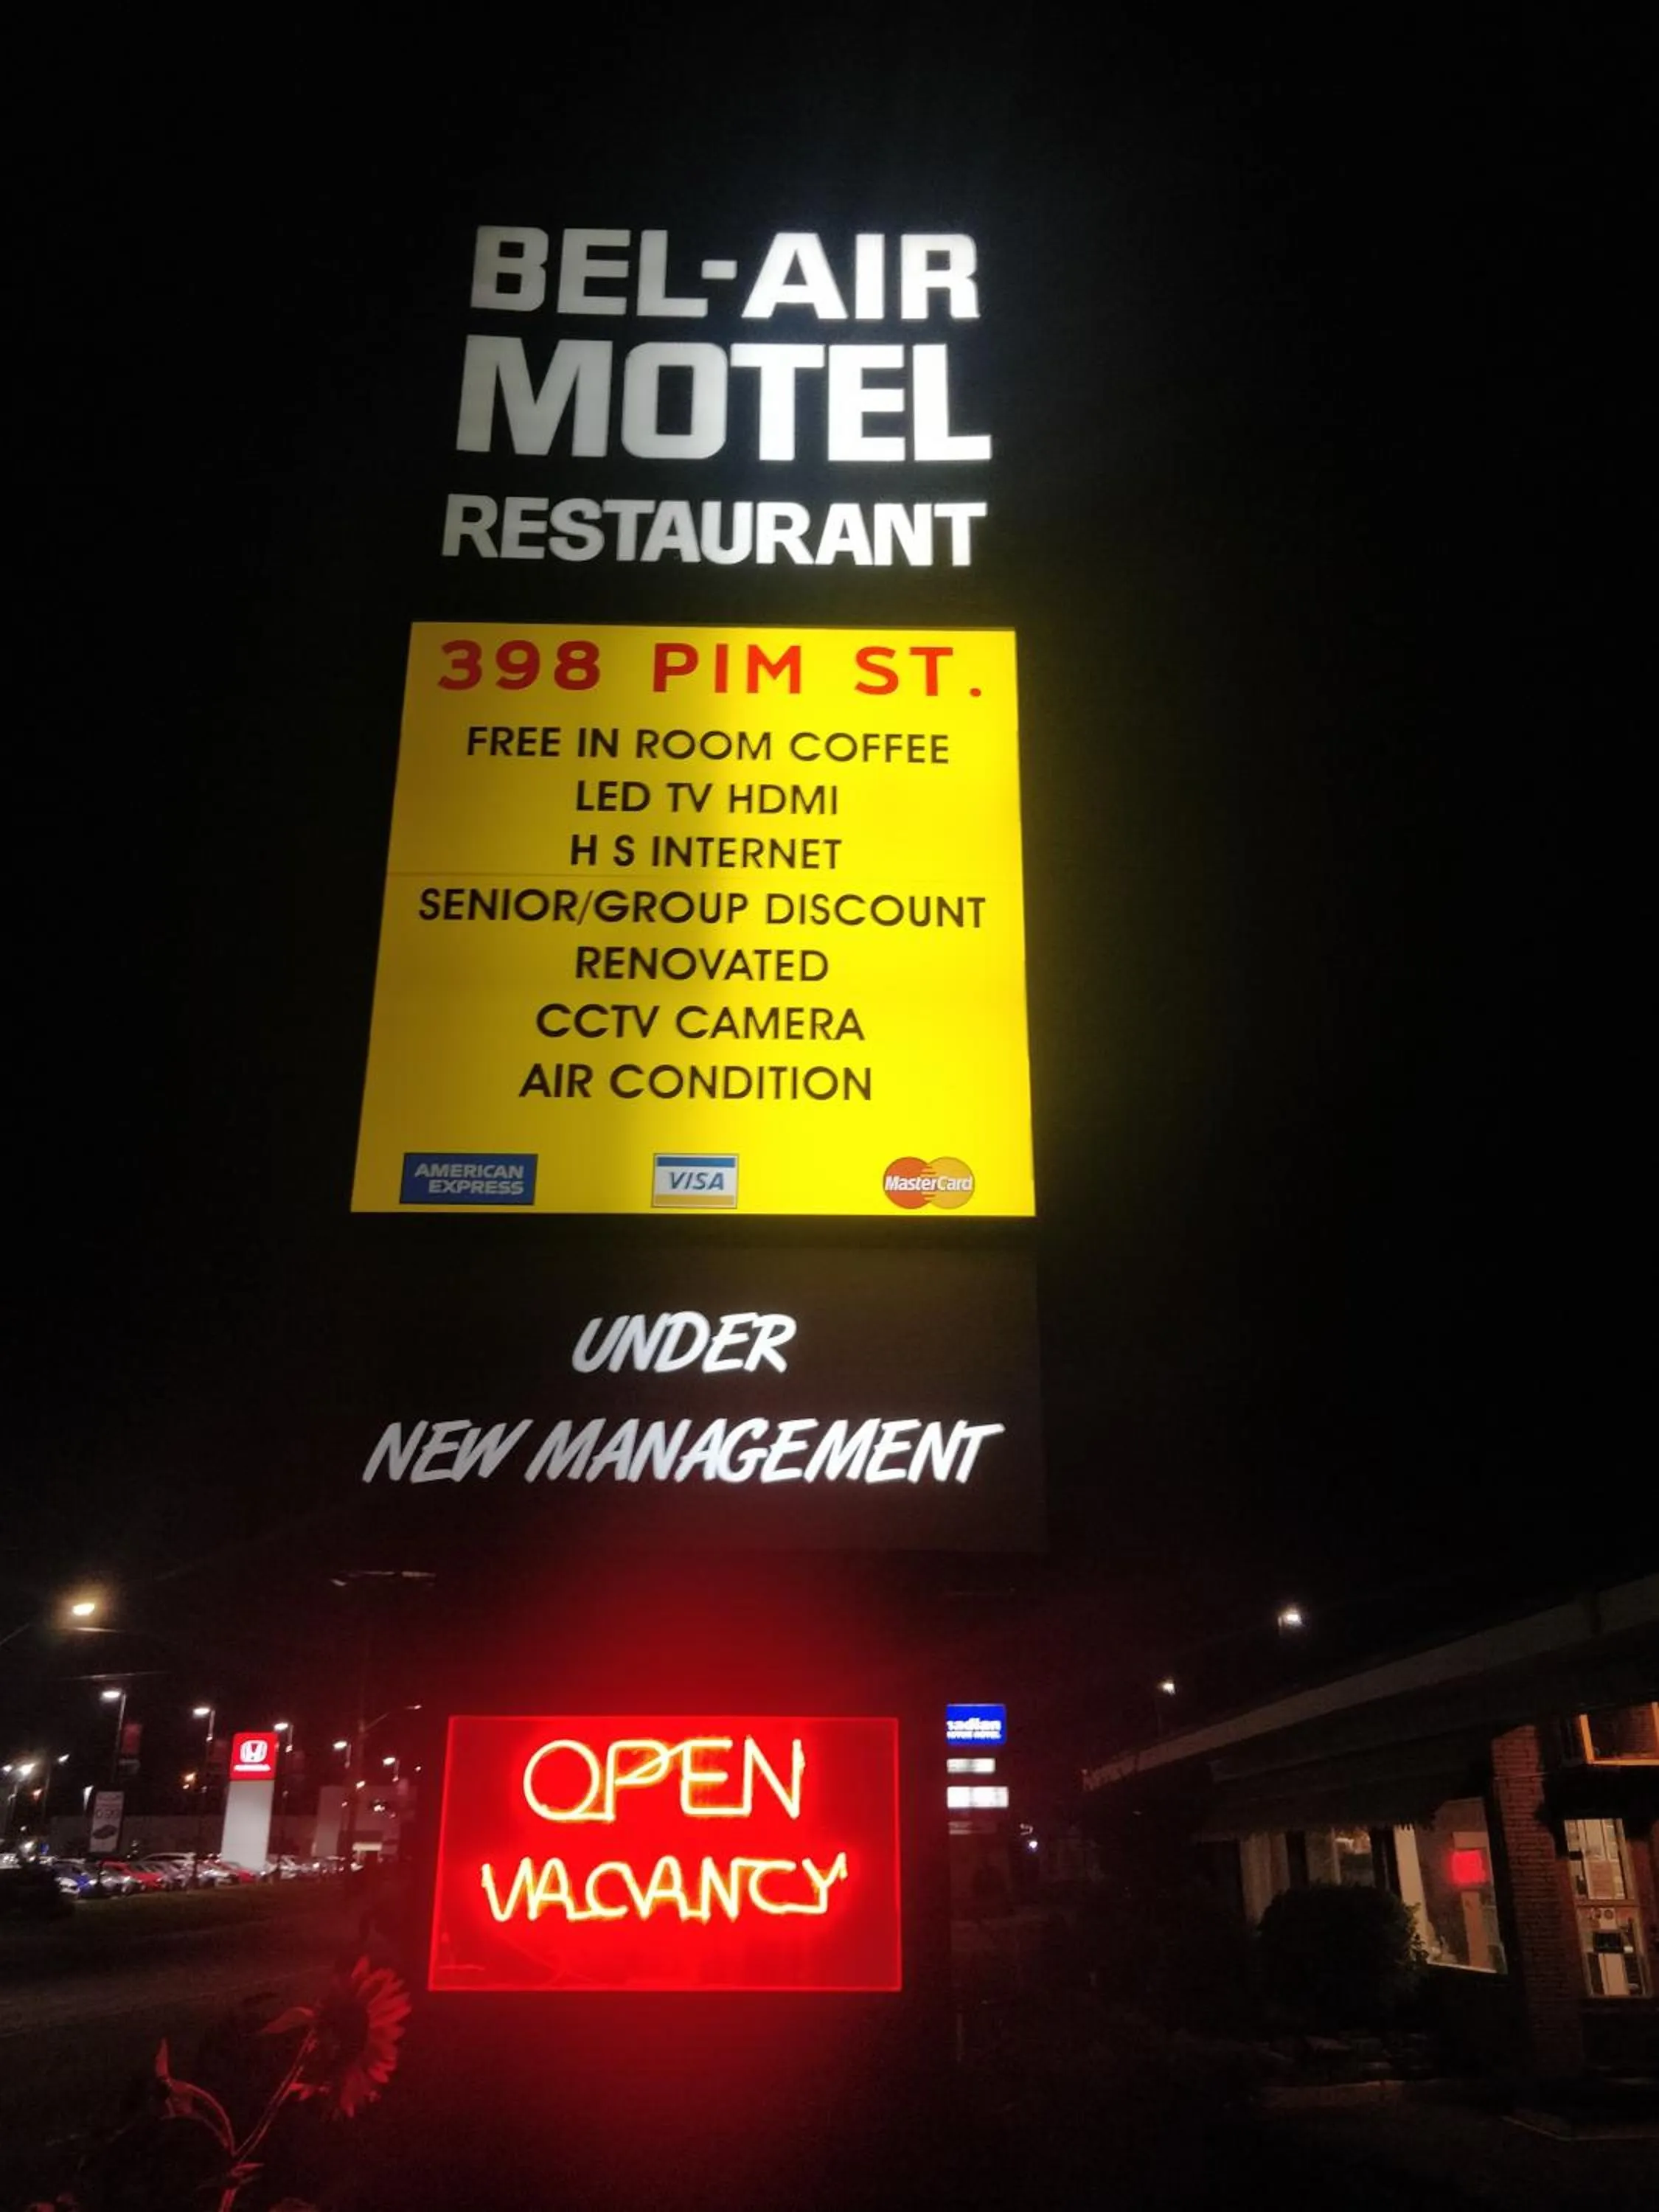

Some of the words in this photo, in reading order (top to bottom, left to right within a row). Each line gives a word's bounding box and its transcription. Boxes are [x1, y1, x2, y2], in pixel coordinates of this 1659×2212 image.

[470, 225, 981, 320] BEL-AIR
[456, 334, 992, 462] MOTEL
[442, 493, 988, 567] RESTAURANT
[437, 639, 601, 692] 398
[653, 642, 802, 695] PIM
[854, 646, 983, 697] ST.
[467, 726, 561, 757] FREE
[577, 728, 619, 759] IN
[635, 729, 772, 761] ROOM
[790, 731, 950, 765] COFFEE
[575, 780, 650, 813] LED
[667, 782, 712, 813] TV
[728, 784, 839, 816] HDMI
[570, 834, 597, 867] H
[613, 835, 636, 867] S
[652, 836, 842, 870] INTERNET
[418, 888, 749, 926] SENIOR/GROUP
[765, 894, 987, 929] DISCOUNT
[574, 946, 830, 982] RENOVATED
[536, 1003, 661, 1040] CCTV
[675, 1005, 865, 1041] CAMERA
[518, 1063, 593, 1099] AIR
[609, 1063, 872, 1102] CONDITION
[414, 1163, 524, 1180] AMERICAN
[428, 1180, 525, 1196] EXPRESS
[667, 1170, 726, 1192] VISA
[884, 1173, 973, 1193] MasterCard
[571, 1311, 797, 1373] UNDER
[362, 1419, 534, 1484] NEW
[524, 1417, 1005, 1484] MANAGEMENT
[523, 1735, 805, 1823] OPEN
[481, 1852, 848, 1925] VACANCY
